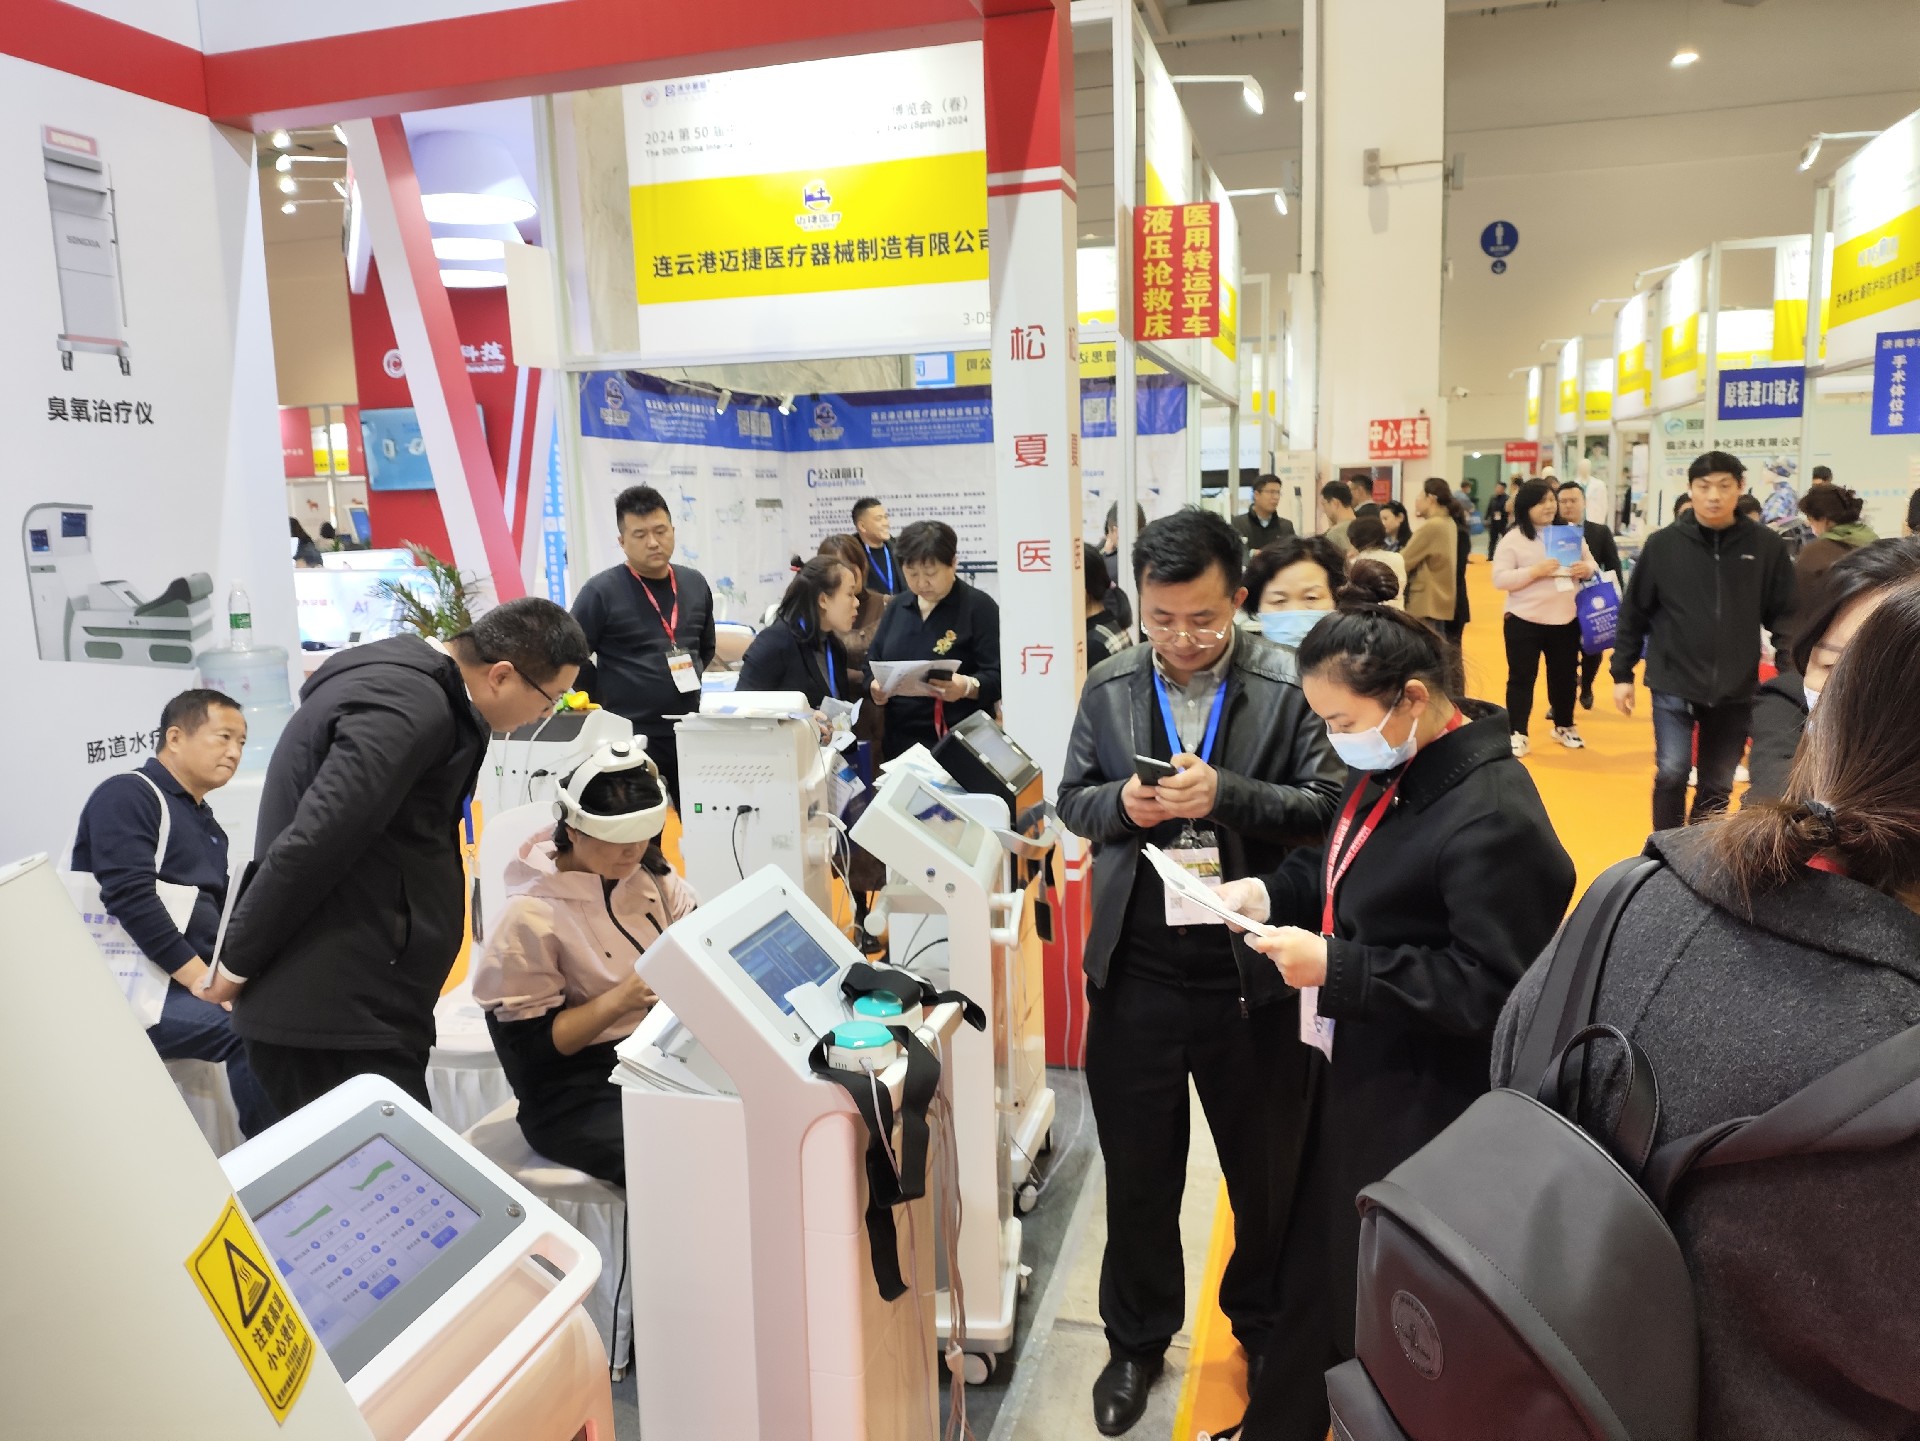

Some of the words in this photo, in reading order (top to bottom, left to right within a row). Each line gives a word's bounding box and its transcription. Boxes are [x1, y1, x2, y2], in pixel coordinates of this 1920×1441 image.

[645, 130, 674, 145] 2024
[694, 126, 709, 139] 50
[947, 115, 968, 125] 2024
[1142, 208, 1174, 338] 液压抢救床
[1182, 204, 1213, 336] 医用转运平车
[47, 397, 154, 425] 臭氧治疗仪
[252, 1292, 284, 1352] 注意高温
[267, 1313, 297, 1371] 小心烫伤
